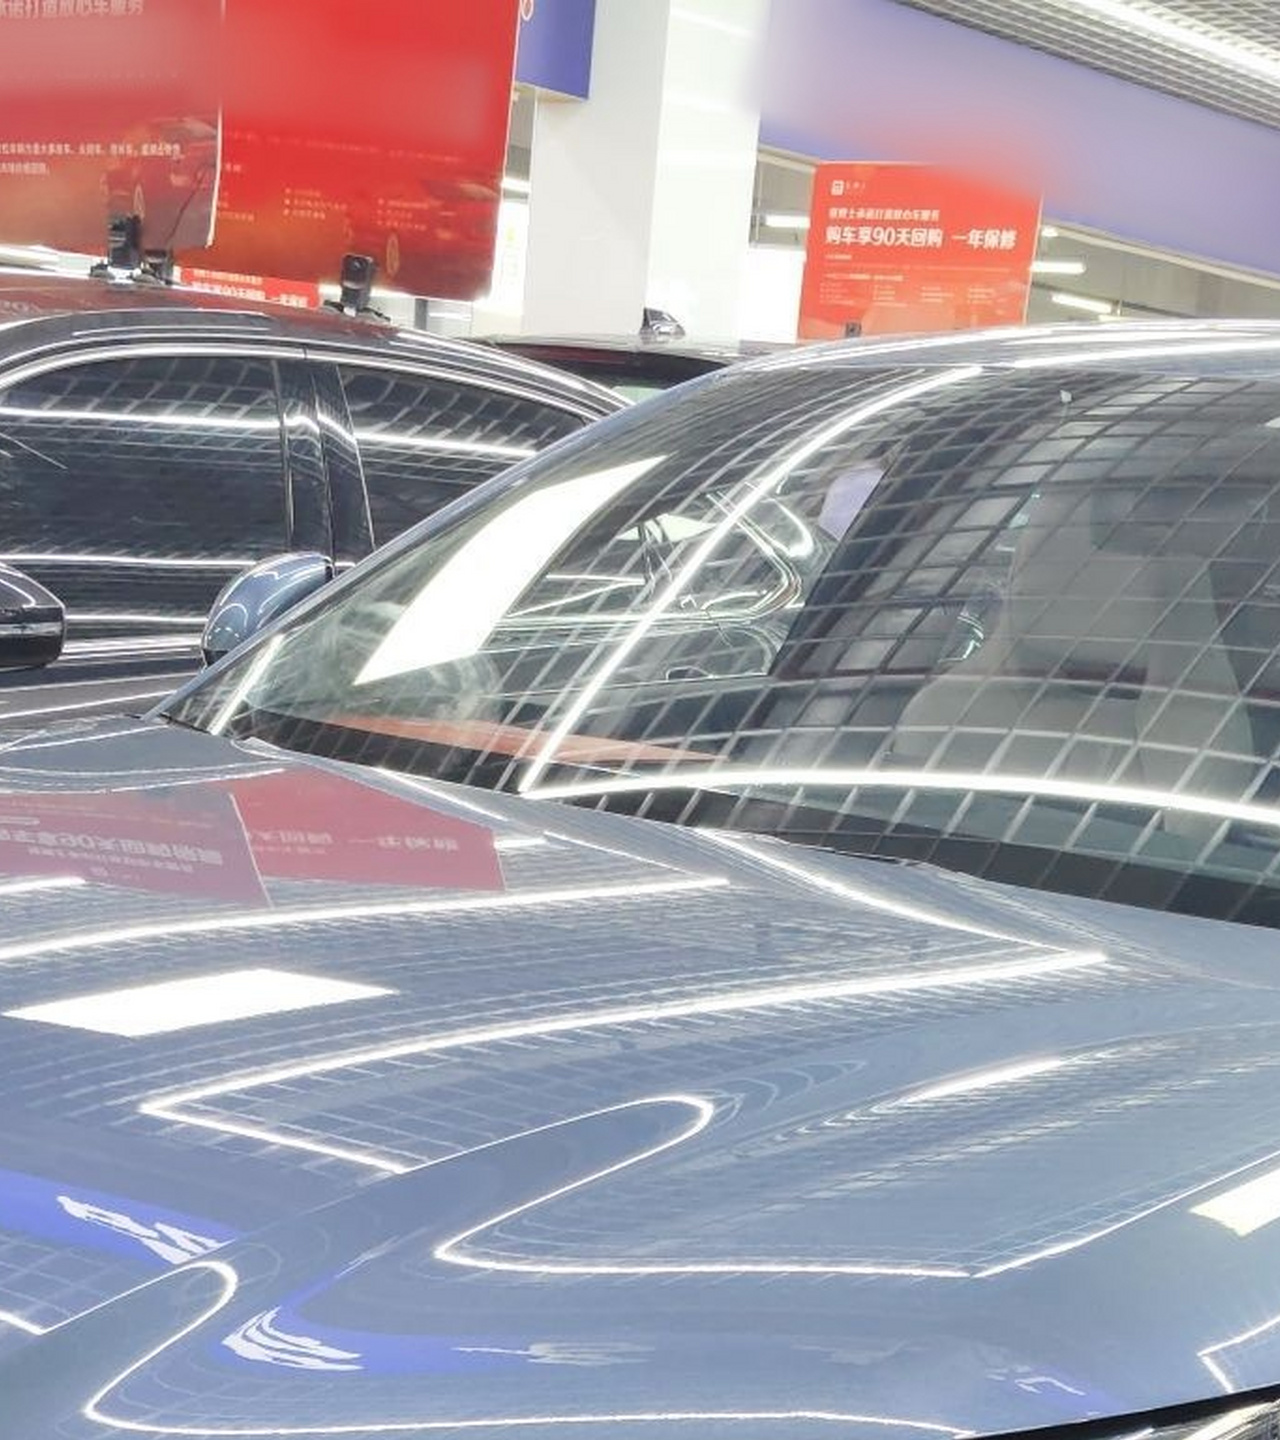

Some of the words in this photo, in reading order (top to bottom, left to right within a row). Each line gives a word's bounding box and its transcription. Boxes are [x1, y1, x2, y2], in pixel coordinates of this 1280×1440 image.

[825, 226, 943, 247] 购车享90天回购
[952, 229, 1018, 250] 一年保修
